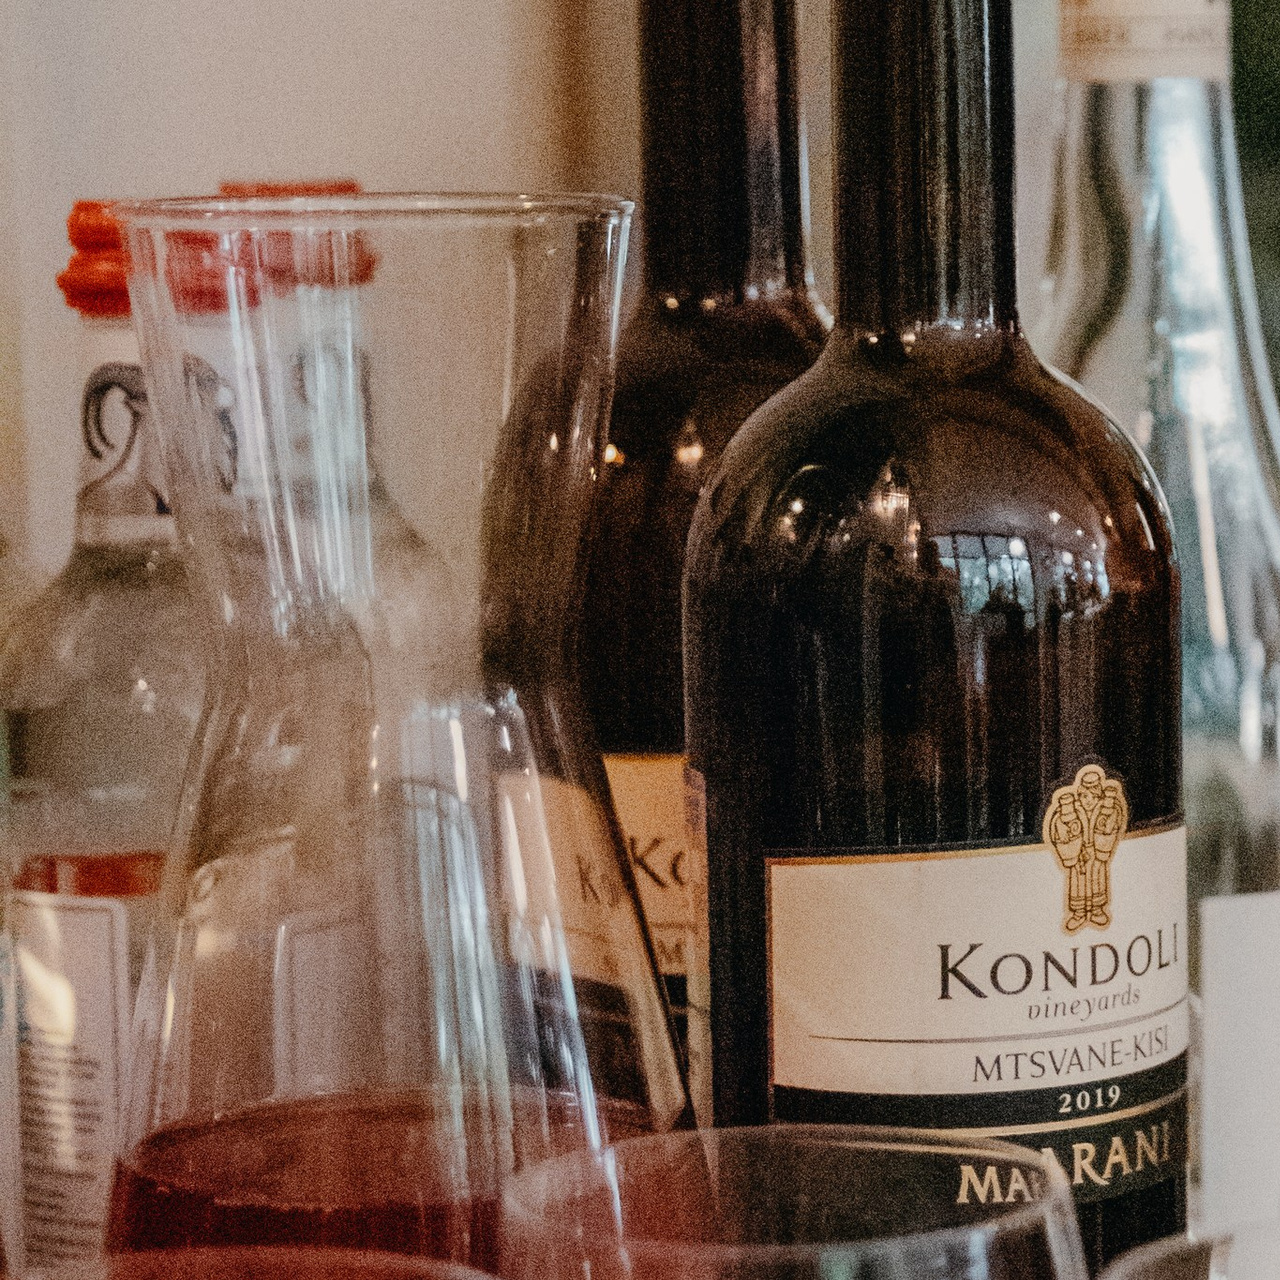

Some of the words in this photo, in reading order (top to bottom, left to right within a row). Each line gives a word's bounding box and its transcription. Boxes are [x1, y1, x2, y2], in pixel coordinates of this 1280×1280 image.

[936, 922, 1179, 1001] KONDOLI
[1027, 982, 1141, 1022] vineyards
[971, 1023, 1170, 1083] MTSVANE-KISI
[1057, 1084, 1122, 1114] 2019
